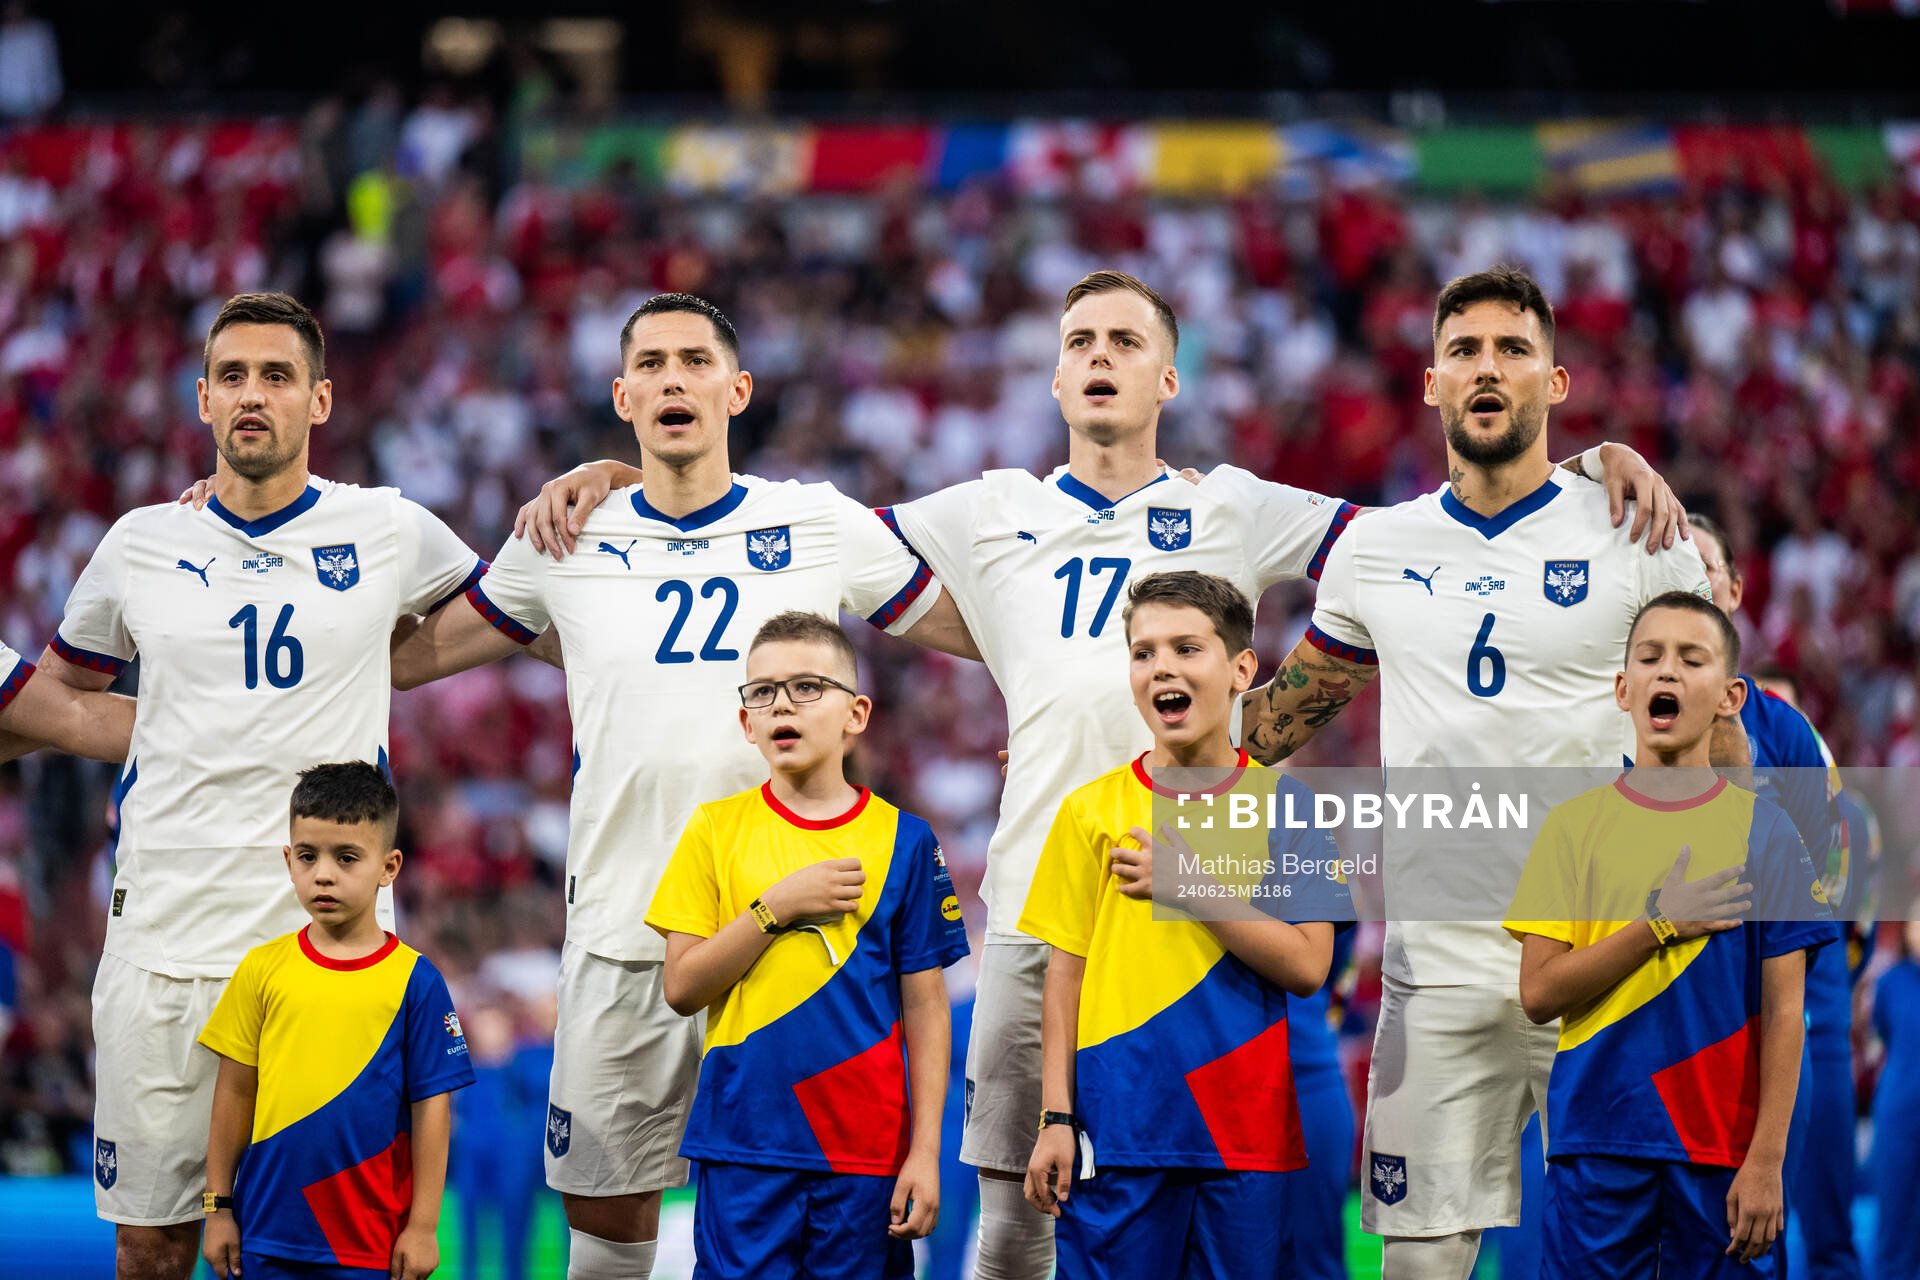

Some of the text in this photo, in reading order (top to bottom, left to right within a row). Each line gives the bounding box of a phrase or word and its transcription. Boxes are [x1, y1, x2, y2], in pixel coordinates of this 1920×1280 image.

[242, 557, 283, 570] DNK-SRB
[667, 540, 710, 551] DNK-SRB
[1465, 580, 1505, 591] DNK-SRB
[655, 576, 739, 664] 22
[1054, 557, 1131, 638] 17
[229, 603, 304, 690] 16
[1467, 612, 1506, 697] 6
